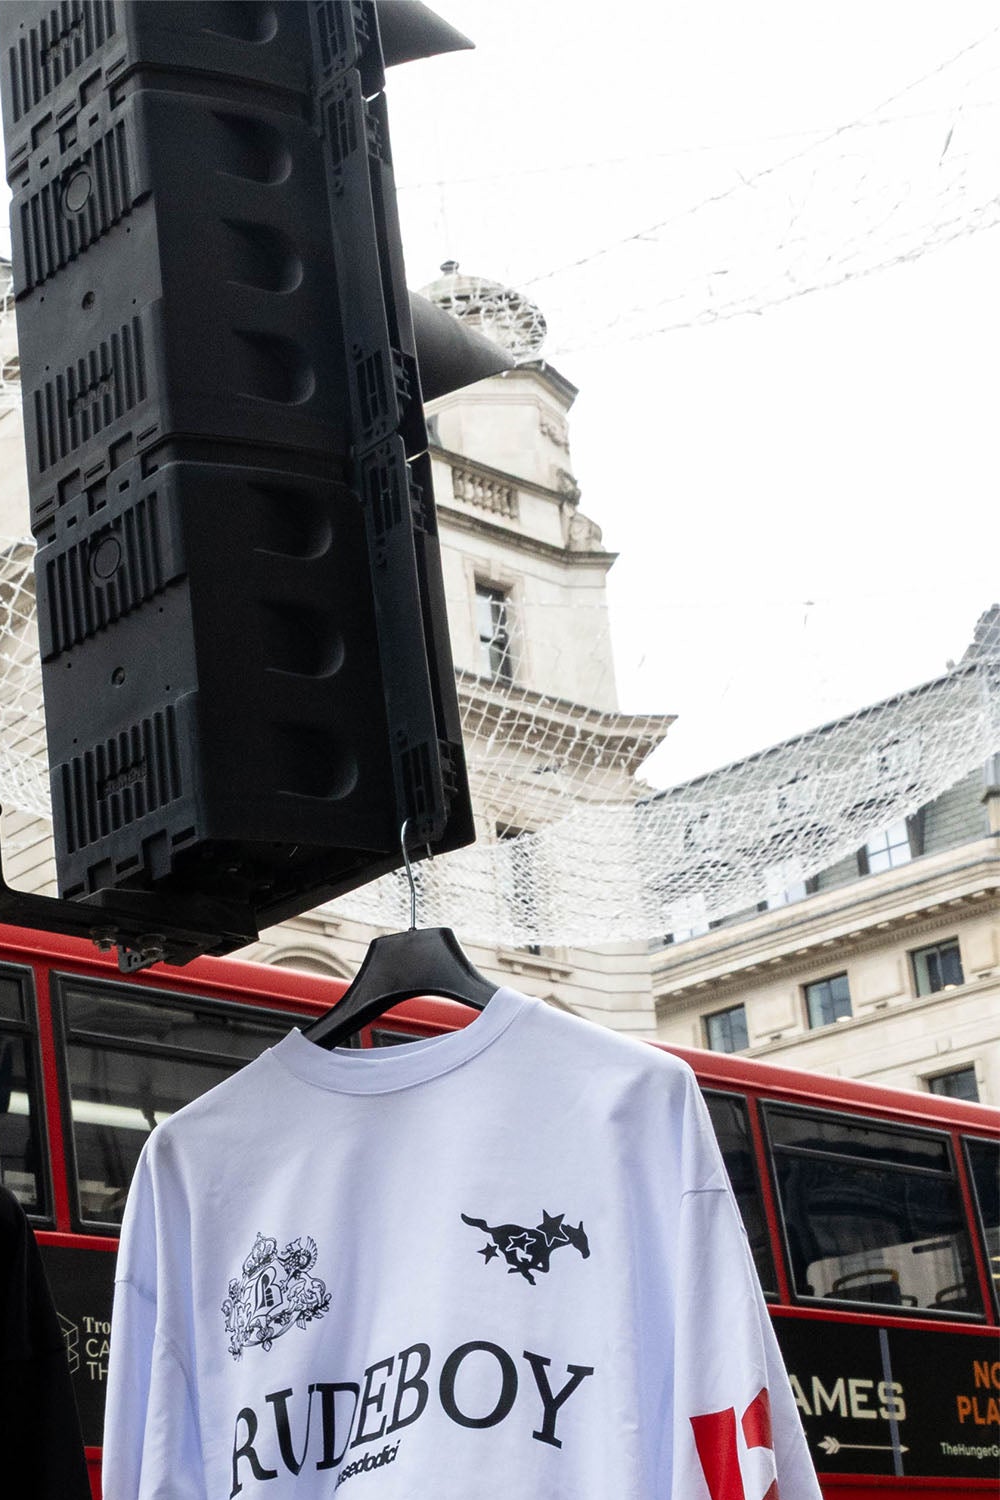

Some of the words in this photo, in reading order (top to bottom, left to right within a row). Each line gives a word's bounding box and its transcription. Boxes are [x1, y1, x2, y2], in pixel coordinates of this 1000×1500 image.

[788, 1374, 906, 1421] AMES
[956, 1396, 1000, 1425] PLA
[228, 1340, 595, 1500] RUDEBOY
[940, 1442, 1000, 1460] TheHungerG
